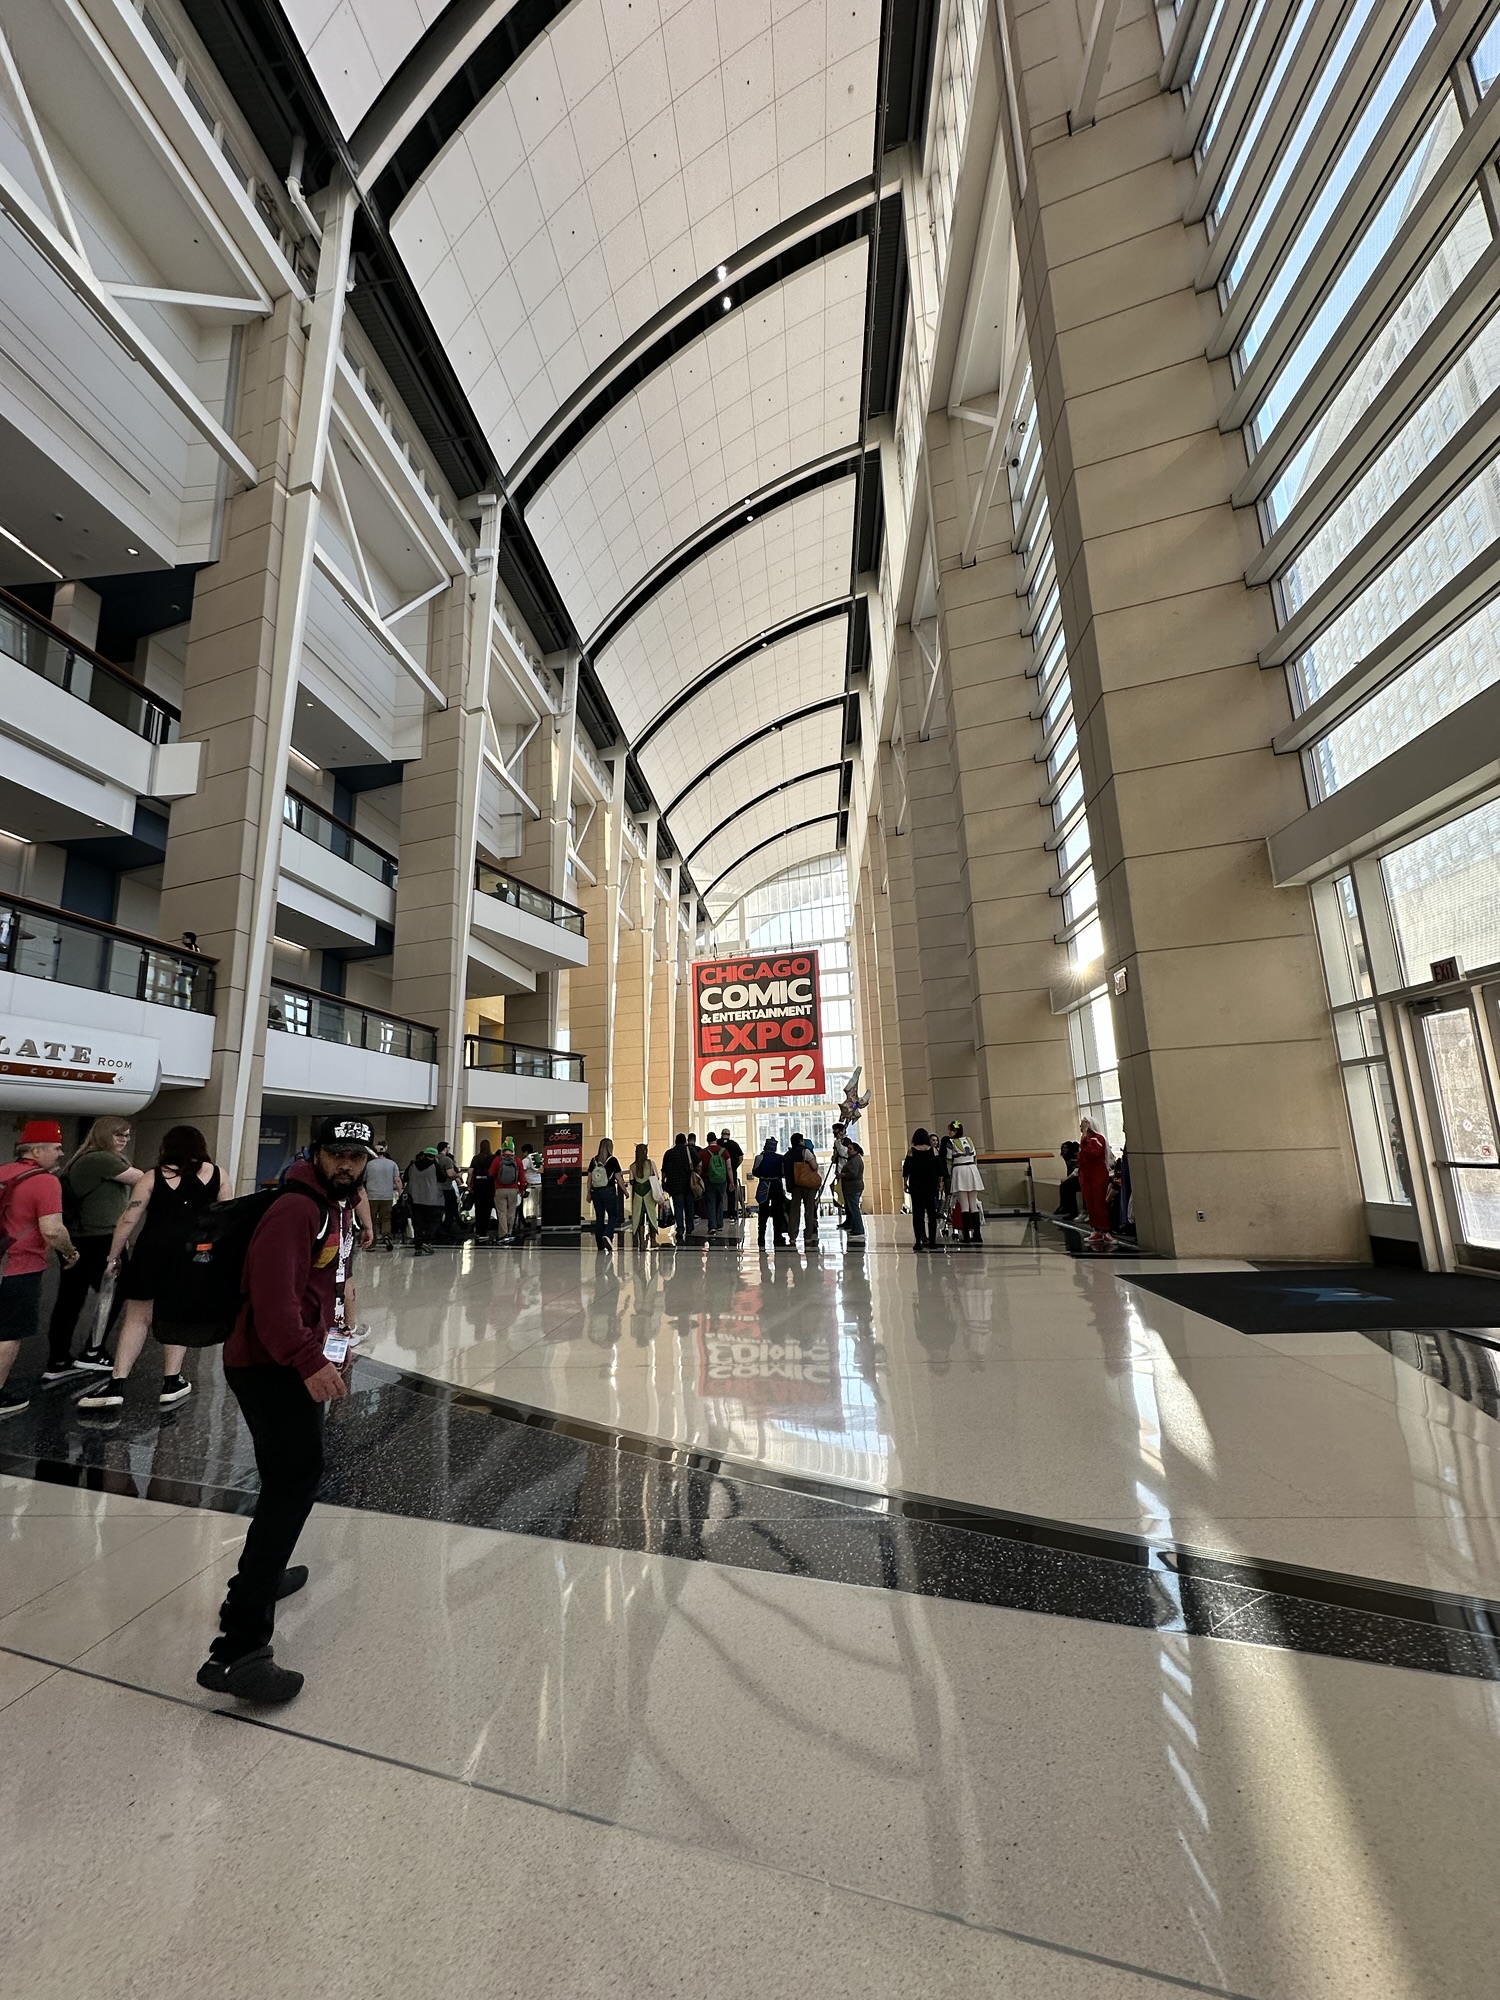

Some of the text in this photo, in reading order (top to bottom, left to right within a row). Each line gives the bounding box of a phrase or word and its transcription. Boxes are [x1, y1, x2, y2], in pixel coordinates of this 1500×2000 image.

[700, 957, 811, 985] CHICAGO
[1433, 961, 1455, 982] EXIT
[700, 978, 812, 1011] COMIC
[700, 1004, 812, 1024] & ENTERTAINMENT
[701, 1018, 814, 1053] EXPO
[30, 1068, 98, 1080] COURT
[700, 1054, 815, 1095] C2E2
[334, 1121, 371, 1133] STAR
[334, 1129, 371, 1141] WARS
